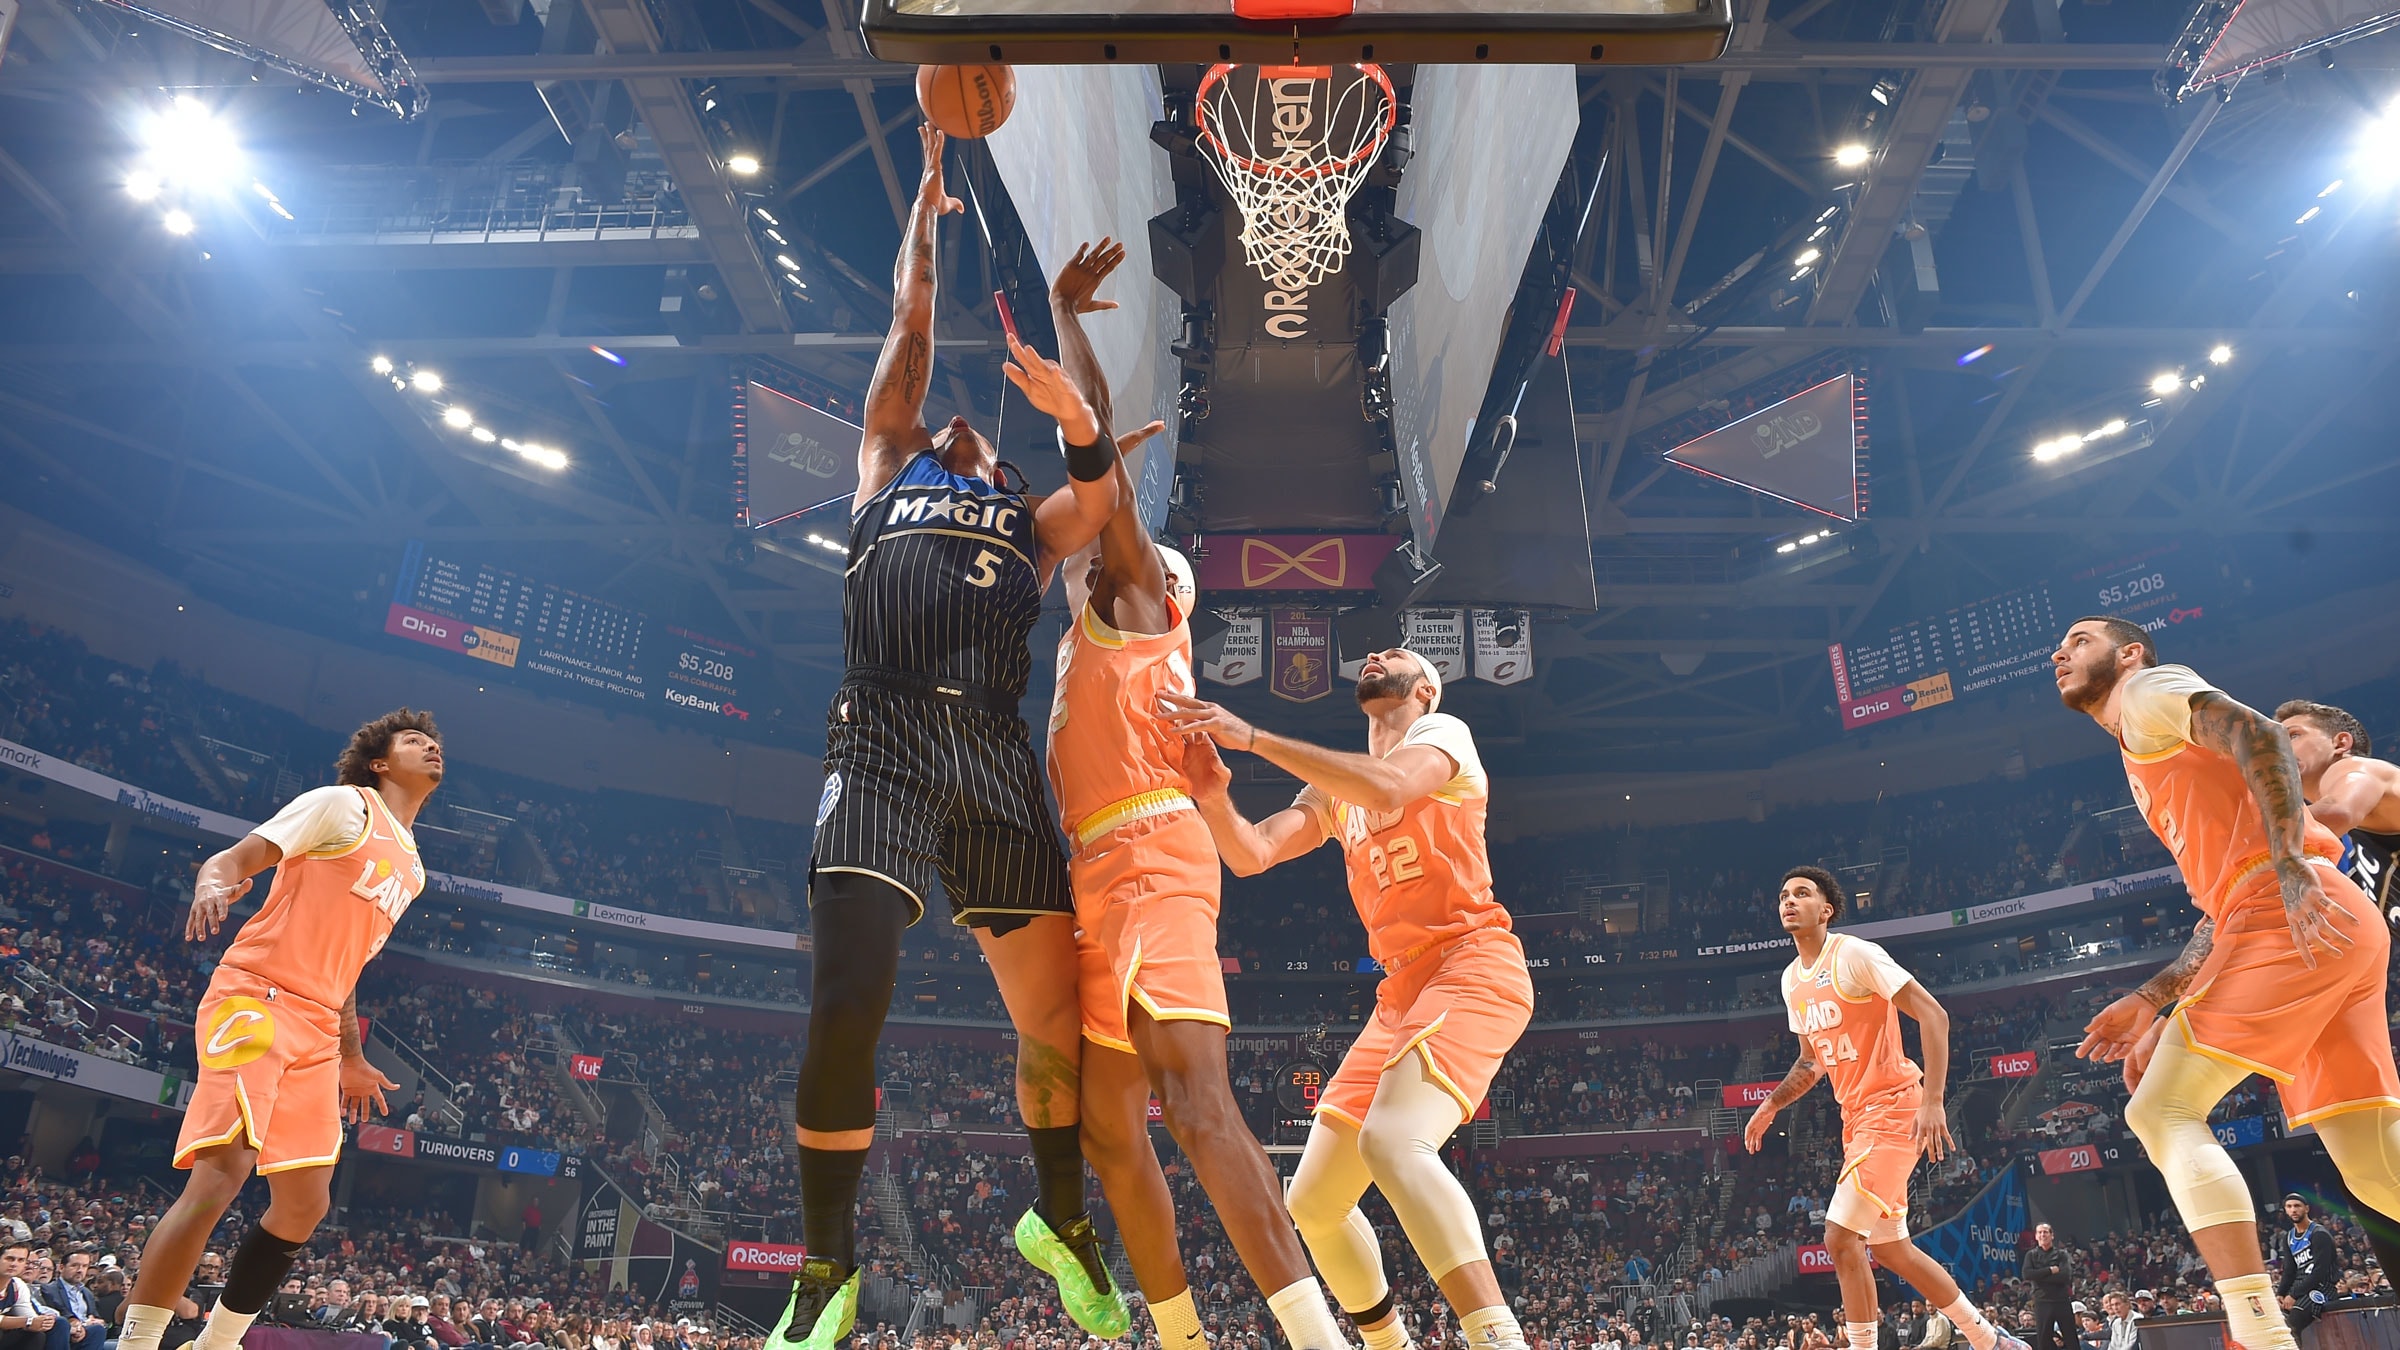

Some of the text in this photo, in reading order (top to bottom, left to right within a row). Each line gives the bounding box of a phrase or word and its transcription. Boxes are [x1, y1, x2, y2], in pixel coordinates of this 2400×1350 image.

[438, 560, 460, 571] BLACK
[965, 549, 1003, 588] 5
[436, 569, 458, 580] JONES
[433, 577, 471, 593] BANCHERO
[2098, 573, 2165, 608] $5,208
[1290, 611, 1312, 620] 201
[402, 614, 448, 638] Ohio
[1228, 624, 1252, 633] TERN
[1292, 627, 1310, 636] NBA
[1416, 624, 1454, 633] EASTERN
[463, 634, 478, 646] CAT
[1226, 635, 1259, 645] ERENCE
[1276, 636, 1326, 647] CHAMPIONS
[1410, 635, 1462, 645] CONFERENCE
[480, 639, 515, 656] Rental
[1221, 646, 1257, 656] AMPIONS
[1412, 646, 1460, 656] CHAMPIONS
[1856, 645, 1871, 653] BALL
[1858, 651, 1881, 661] PORTER
[678, 651, 734, 681] $5,208
[1859, 659, 1878, 669] NANCE
[1861, 664, 1889, 677] PROCTOR
[527, 660, 563, 677] NUMBER
[607, 681, 646, 700] PROCTOR
[626, 673, 643, 685] AND
[1832, 645, 1848, 702] CAVALIERS
[1863, 673, 1885, 684] TOMLIN
[1918, 683, 1949, 698] Rental
[1963, 677, 1997, 693] NUMBER
[665, 688, 721, 713] KeyBank
[1902, 692, 1915, 703] CAT
[1852, 701, 1890, 719] Ohio
[0, 745, 41, 769] mark
[144, 797, 201, 829] Technologies
[1369, 835, 1424, 892] 22
[450, 880, 504, 902] Technologies
[2093, 872, 2173, 900] Blue Technologies
[594, 905, 647, 927] Lexmark
[1972, 900, 2027, 921] Lexmark
[1639, 949, 1678, 961] 7:32 PM
[1698, 946, 1723, 957] LET
[1726, 943, 1746, 954] EM
[1525, 957, 1567, 968] OULS 1
[1584, 952, 1623, 964] TOL 7
[1254, 961, 1260, 970] 9
[1286, 961, 1309, 970] 2:33
[1332, 961, 1350, 971] 1Q
[683, 1004, 704, 1015] M125
[1002, 1032, 1017, 1041] M12
[1579, 1030, 1599, 1040] M102
[1227, 1038, 1289, 1056] ntington
[1817, 1033, 1859, 1067] 24
[9, 1038, 80, 1079] Technologies
[578, 1060, 600, 1077] fub
[1998, 1059, 2031, 1074] fubo
[1292, 1072, 1321, 1085] 2:33
[1303, 1086, 1318, 1110] 9
[2217, 1127, 2237, 1146] 26
[2272, 1126, 2279, 1139] 1
[393, 1134, 404, 1151] 5
[419, 1139, 495, 1162] TURNOVERS
[2104, 1148, 2119, 1160] 1Q
[508, 1152, 519, 1168] 0
[566, 1156, 582, 1166] FG%
[2069, 1150, 2090, 1168] 20
[564, 1166, 577, 1177] 56
[2029, 1164, 2036, 1175] 1
[586, 1219, 616, 1233] IN THE
[1970, 1224, 1993, 1242] Full
[584, 1233, 614, 1249] PAINT
[748, 1248, 803, 1267] Rocket
[1982, 1243, 2017, 1263] Powe
[669, 1299, 705, 1310] SHERWIN
